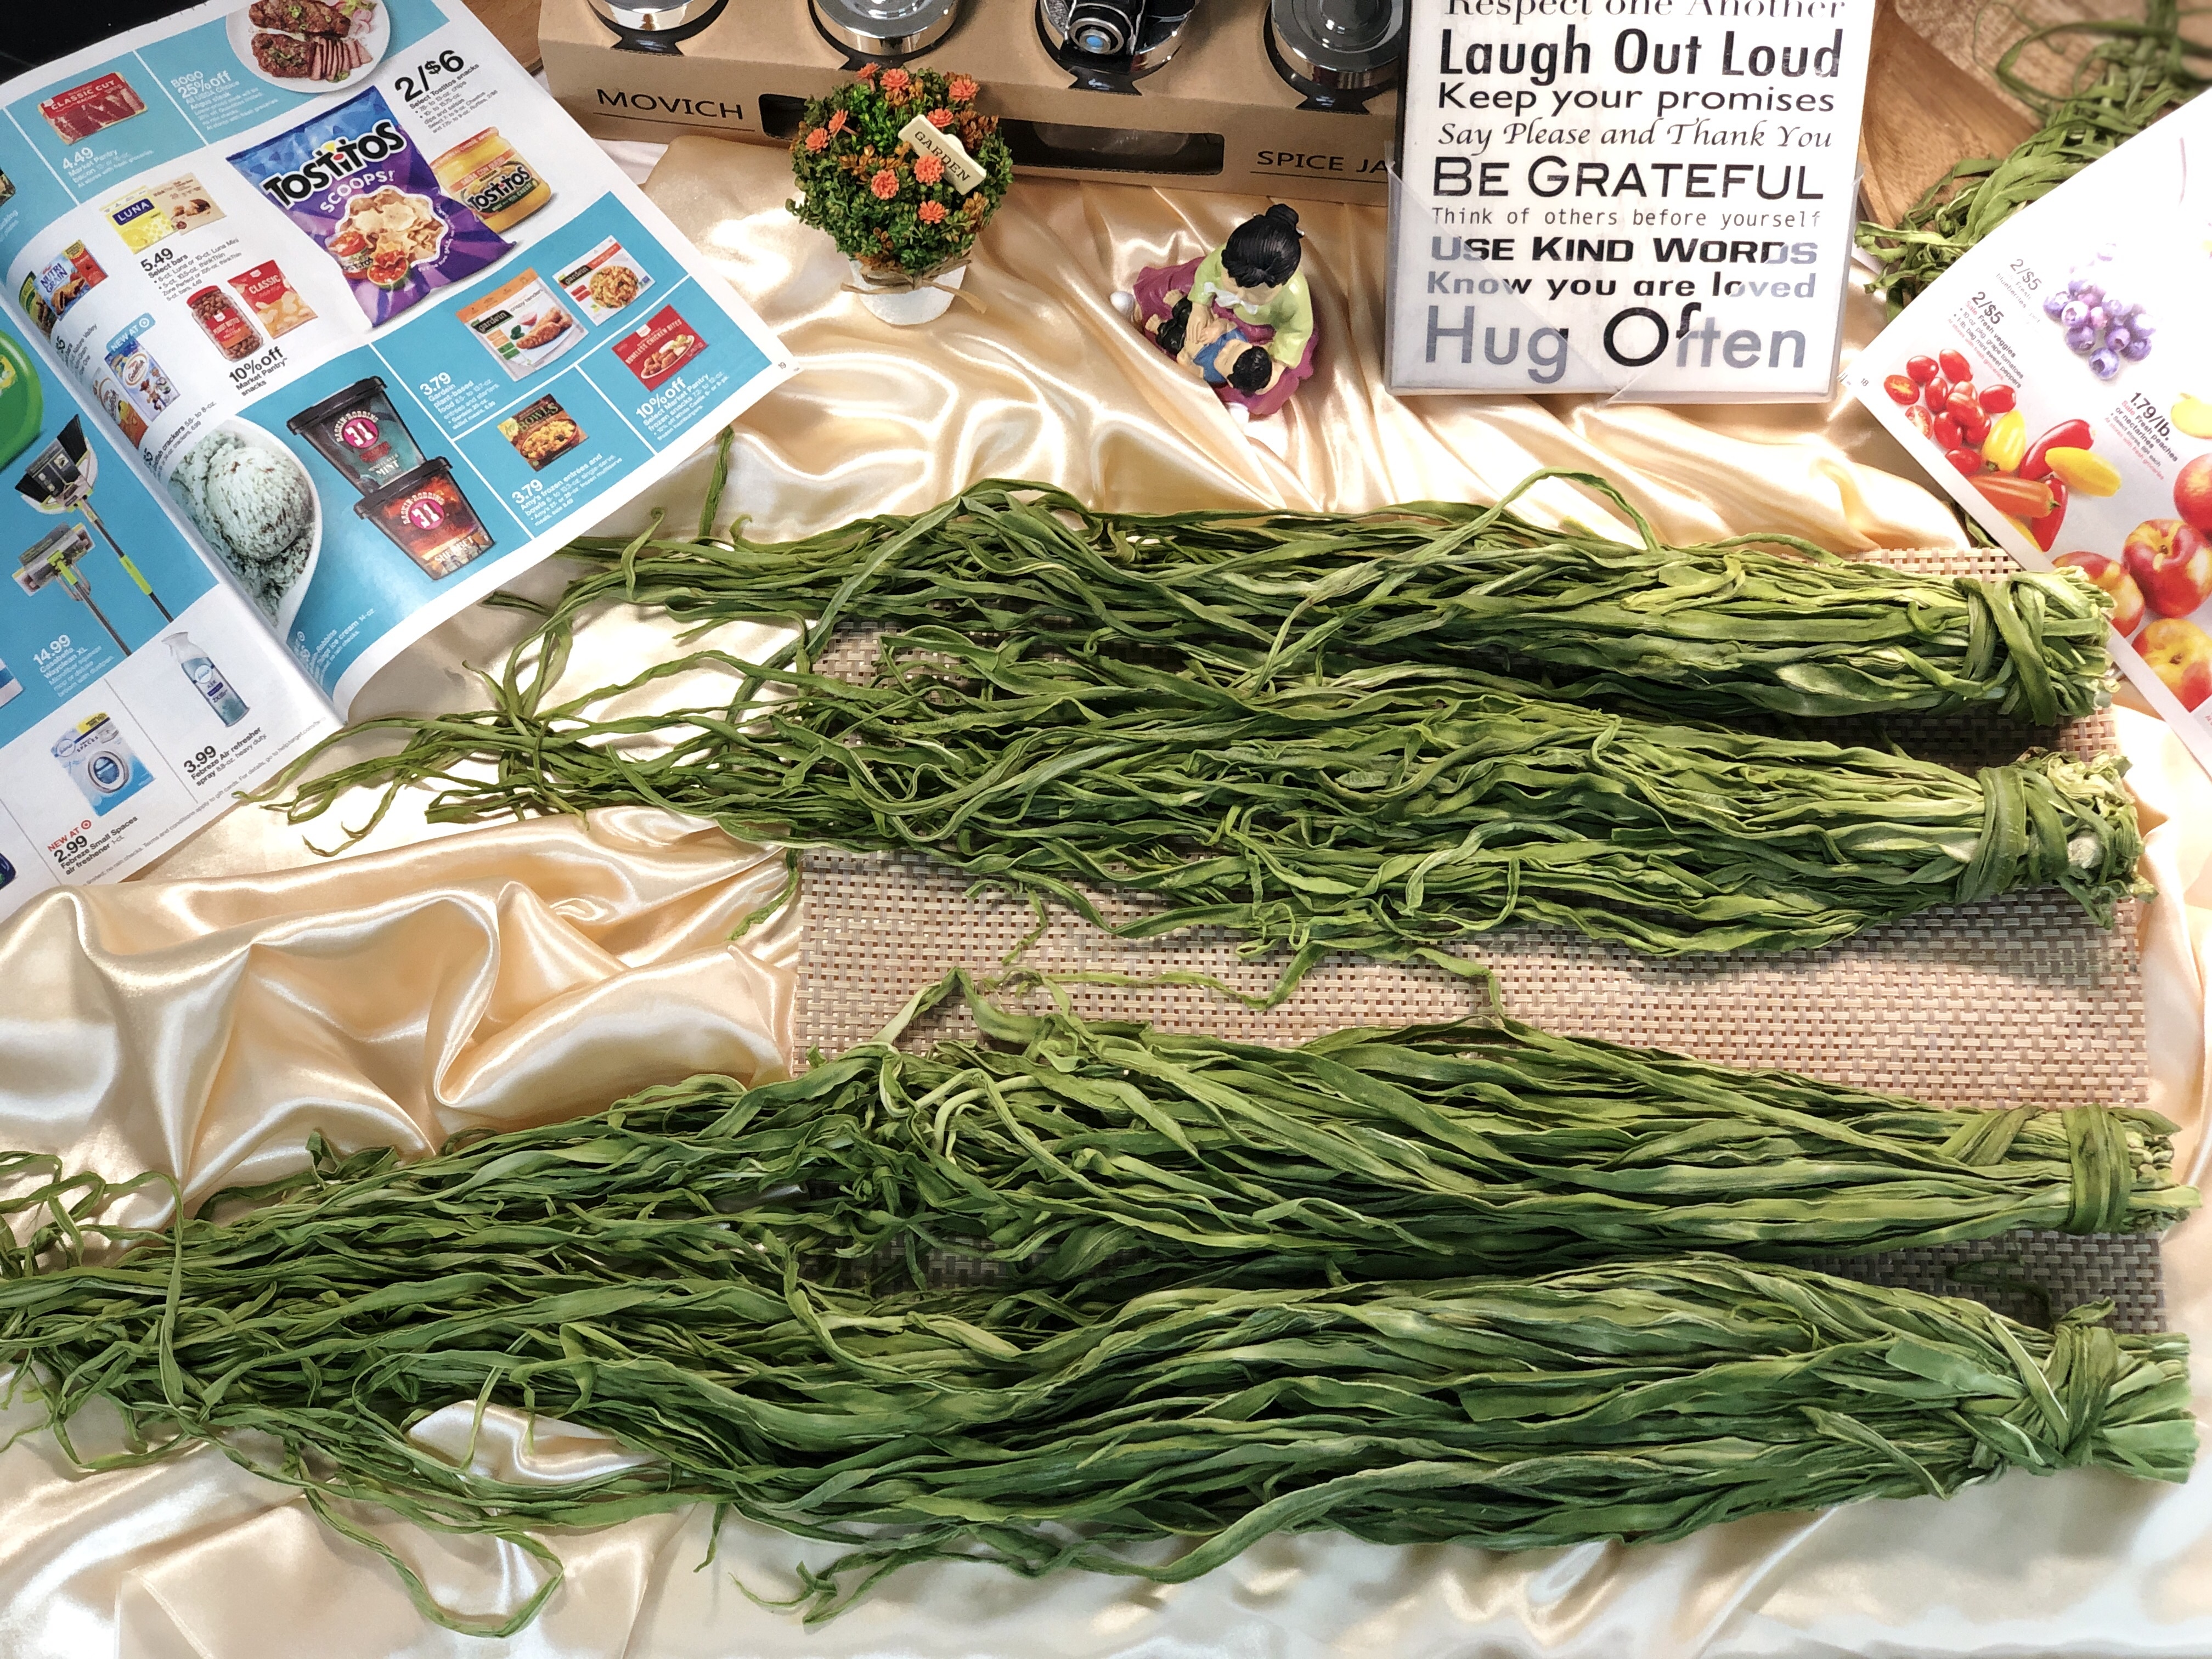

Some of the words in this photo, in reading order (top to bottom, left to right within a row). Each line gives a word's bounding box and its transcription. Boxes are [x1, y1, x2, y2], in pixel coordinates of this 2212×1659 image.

[1440, 24, 1591, 86] Laugh
[1614, 28, 1701, 75] Out
[1722, 29, 1843, 78] Loud
[171, 71, 203, 88] BOGO
[216, 81, 239, 93] Choice
[395, 50, 464, 101] 2/$6
[409, 95, 431, 109] Select
[431, 80, 456, 95] Tostitos
[456, 64, 479, 80] snacks
[51, 89, 93, 110] CLASSIC
[95, 80, 114, 91] CUT
[212, 92, 231, 102] steak
[596, 88, 743, 120] MOVICH
[1438, 82, 1537, 116] Keep
[1551, 88, 1642, 116] your
[1658, 86, 1835, 116] promises
[437, 108, 448, 117] and
[1437, 122, 1492, 156] Say
[1503, 117, 1590, 144] Please
[1600, 117, 1656, 145] and
[1666, 117, 1765, 146] Thank
[1777, 125, 1832, 148] You
[63, 147, 93, 169] 4.49
[68, 161, 94, 177] Market
[93, 150, 117, 163] Pantry
[263, 122, 404, 207] TOSTITOS
[915, 131, 971, 181] GARDEN
[1257, 150, 1344, 171] SPICE
[72, 168, 96, 183] bacon
[461, 173, 477, 185] SALSA
[477, 166, 489, 176] CON
[468, 167, 529, 210] TOSTITOS
[1432, 156, 1510, 197] BE
[1528, 155, 1824, 200] GRATEFUL
[320, 170, 395, 213] SCOOPS!
[117, 202, 149, 221] LUNA
[1431, 207, 1492, 225] Think
[1507, 208, 1530, 225] of
[1544, 207, 1617, 225] others
[1633, 208, 1707, 227] before
[1720, 211, 1821, 230] yourself
[141, 248, 173, 272] 5.49
[172, 263, 188, 274] Luna
[210, 244, 227, 253] Luna
[1431, 236, 1515, 262] USE
[1532, 236, 1634, 262] KIND
[1653, 237, 1818, 265] WORDS
[40, 263, 62, 286] NUTRI
[45, 269, 67, 293] GRAIN
[148, 263, 171, 278] Select
[171, 255, 188, 266] bars
[565, 267, 588, 285] gardein
[2010, 259, 2041, 290] 2/$5
[249, 275, 280, 294] CLASSIC
[1427, 270, 1532, 295] Know
[1548, 278, 1616, 301] you
[1633, 278, 1695, 297] are
[1712, 272, 1816, 298] loved
[478, 312, 507, 331] gardein
[1972, 291, 2004, 324] 2/$5
[111, 332, 128, 351] NEW
[129, 325, 138, 336] AT
[625, 343, 647, 364] BONELESS
[646, 328, 667, 345] CHICKEN
[667, 319, 682, 331] BITES
[1425, 304, 1569, 385] Hug
[1603, 302, 1807, 369] Often
[1966, 301, 1978, 315] Sale
[1977, 314, 1994, 334] Fresh
[1994, 334, 2016, 358] veggies
[72, 338, 84, 354] Nature
[1966, 328, 1977, 341] bag
[1976, 339, 1988, 351] mini
[1986, 351, 2001, 366] sweet
[2000, 366, 2021, 388] peppers
[1986, 339, 2001, 354] grape
[2001, 353, 2023, 379] tomatoes
[236, 374, 262, 390] Market
[241, 380, 267, 396] snacks
[420, 372, 450, 395] 3.79
[428, 384, 455, 402] Gardein
[433, 380, 473, 408] plant-based
[1860, 378, 1869, 387] 18
[643, 408, 664, 426] Select
[664, 391, 687, 410] Market
[687, 374, 709, 392] Pantry
[648, 414, 670, 431] frozen
[670, 397, 692, 415] snacks
[517, 403, 559, 433] BOWLS
[2121, 400, 2135, 415] Sale
[2135, 415, 2152, 435] Fresh
[2151, 435, 2177, 461] peaches
[2131, 393, 2170, 441] 1.79/lb.
[162, 426, 185, 451] crackers
[2123, 415, 2154, 449] nectarines
[376, 460, 399, 477] MINT
[521, 495, 541, 510] Amy's
[540, 481, 563, 496] frozen
[563, 464, 589, 482] entrées
[589, 454, 602, 465] and
[512, 479, 543, 504] 3.79
[524, 501, 546, 516] bowls
[329, 639, 339, 649] ice
[338, 620, 359, 639] cream
[33, 635, 70, 664] 14.99
[184, 746, 216, 772] 3.99
[191, 759, 219, 780] Febreze
[219, 751, 229, 760] Air
[231, 727, 261, 752] refresher
[196, 770, 216, 786] spray
[235, 744, 252, 758] heavy
[48, 835, 67, 851] NEW
[70, 827, 80, 838] AT
[54, 836, 87, 862] 2.99
[60, 849, 89, 869] Febreze
[89, 833, 111, 850] Small
[110, 816, 138, 836] Spaces
[65, 866, 75, 875] air
[76, 844, 110, 867] freshener
